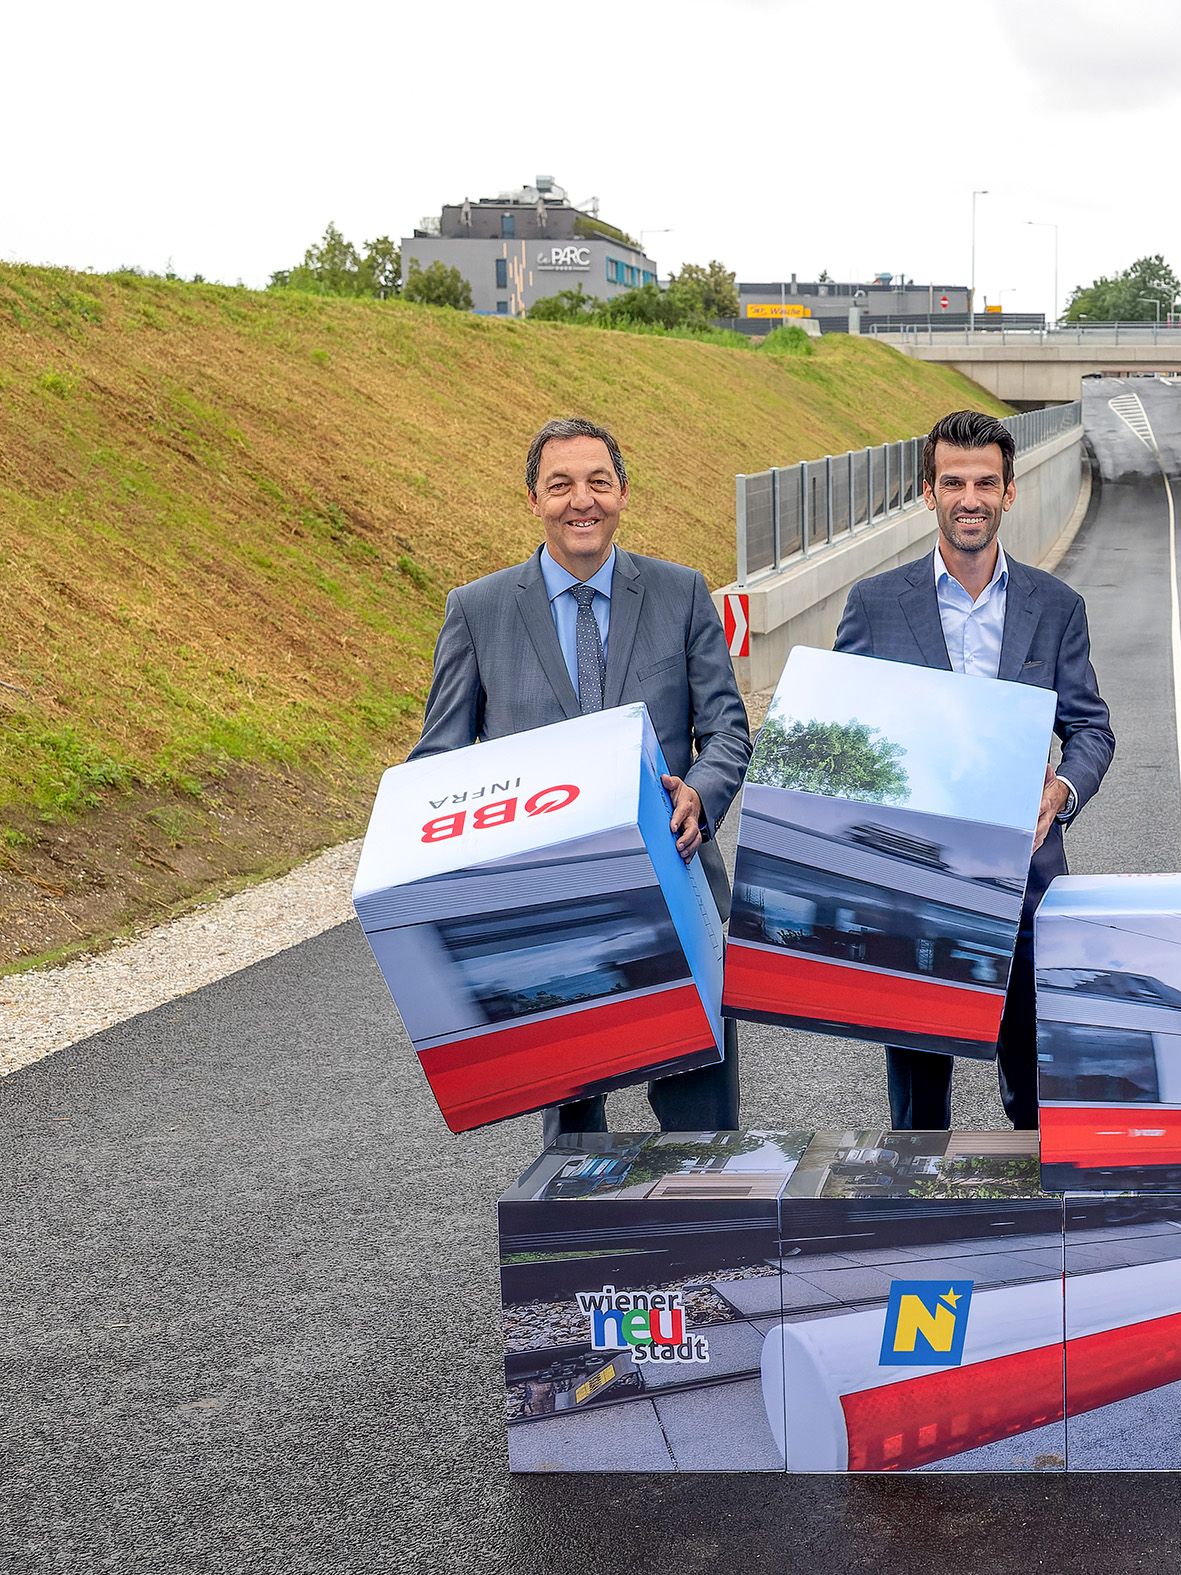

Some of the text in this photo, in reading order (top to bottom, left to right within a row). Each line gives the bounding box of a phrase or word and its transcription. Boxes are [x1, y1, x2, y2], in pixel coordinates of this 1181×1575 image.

[551, 246, 591, 265] PARC
[429, 777, 520, 809] INFRA
[421, 784, 580, 843] ÖBB
[579, 1288, 679, 1313] wiener
[593, 1308, 683, 1347] neu
[634, 1336, 707, 1360] stadt
